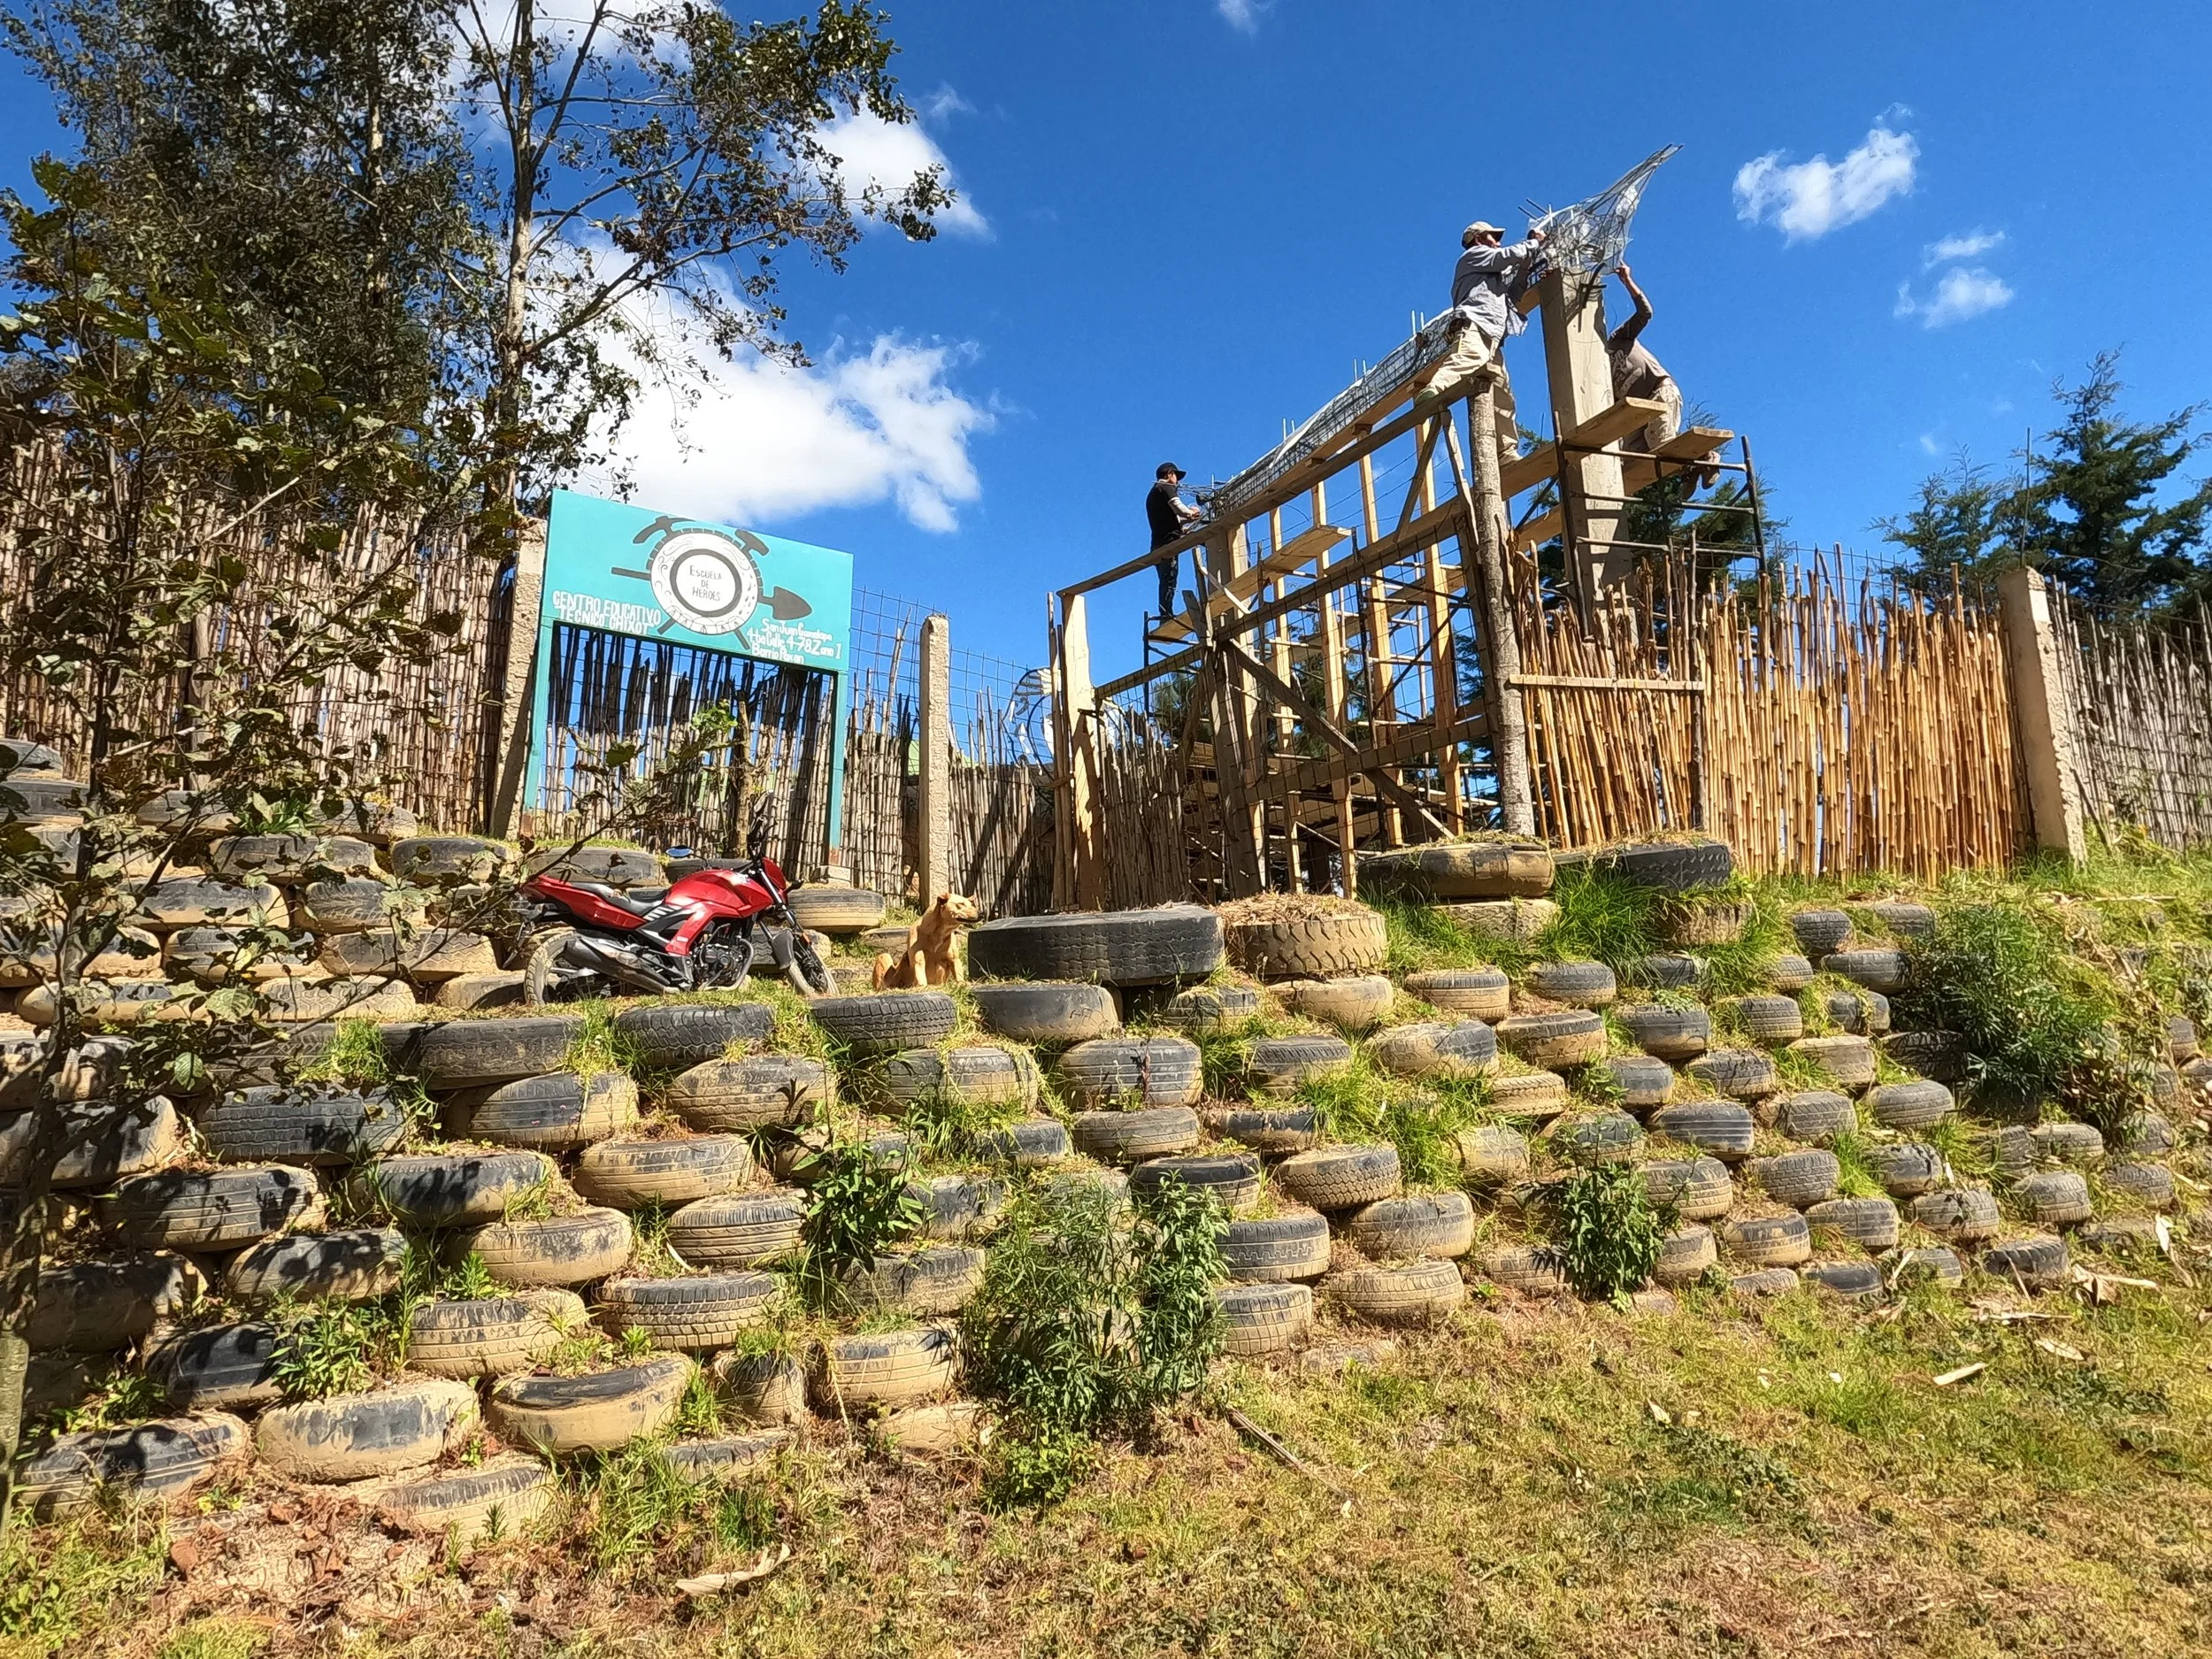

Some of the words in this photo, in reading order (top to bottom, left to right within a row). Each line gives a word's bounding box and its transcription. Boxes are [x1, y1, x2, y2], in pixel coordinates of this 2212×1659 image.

[689, 565, 722, 580] ESCUELA
[701, 580, 710, 589] DE
[692, 586, 721, 602] HEROES
[552, 590, 602, 613] CENTRO
[603, 599, 661, 626] EDUCATIVO
[554, 605, 605, 626] TECNICO
[761, 618, 779, 633] San
[779, 620, 798, 636] Juan
[751, 642, 779, 660] Barrio
[766, 631, 786, 649] Calle
[786, 635, 812, 653] 4-78
